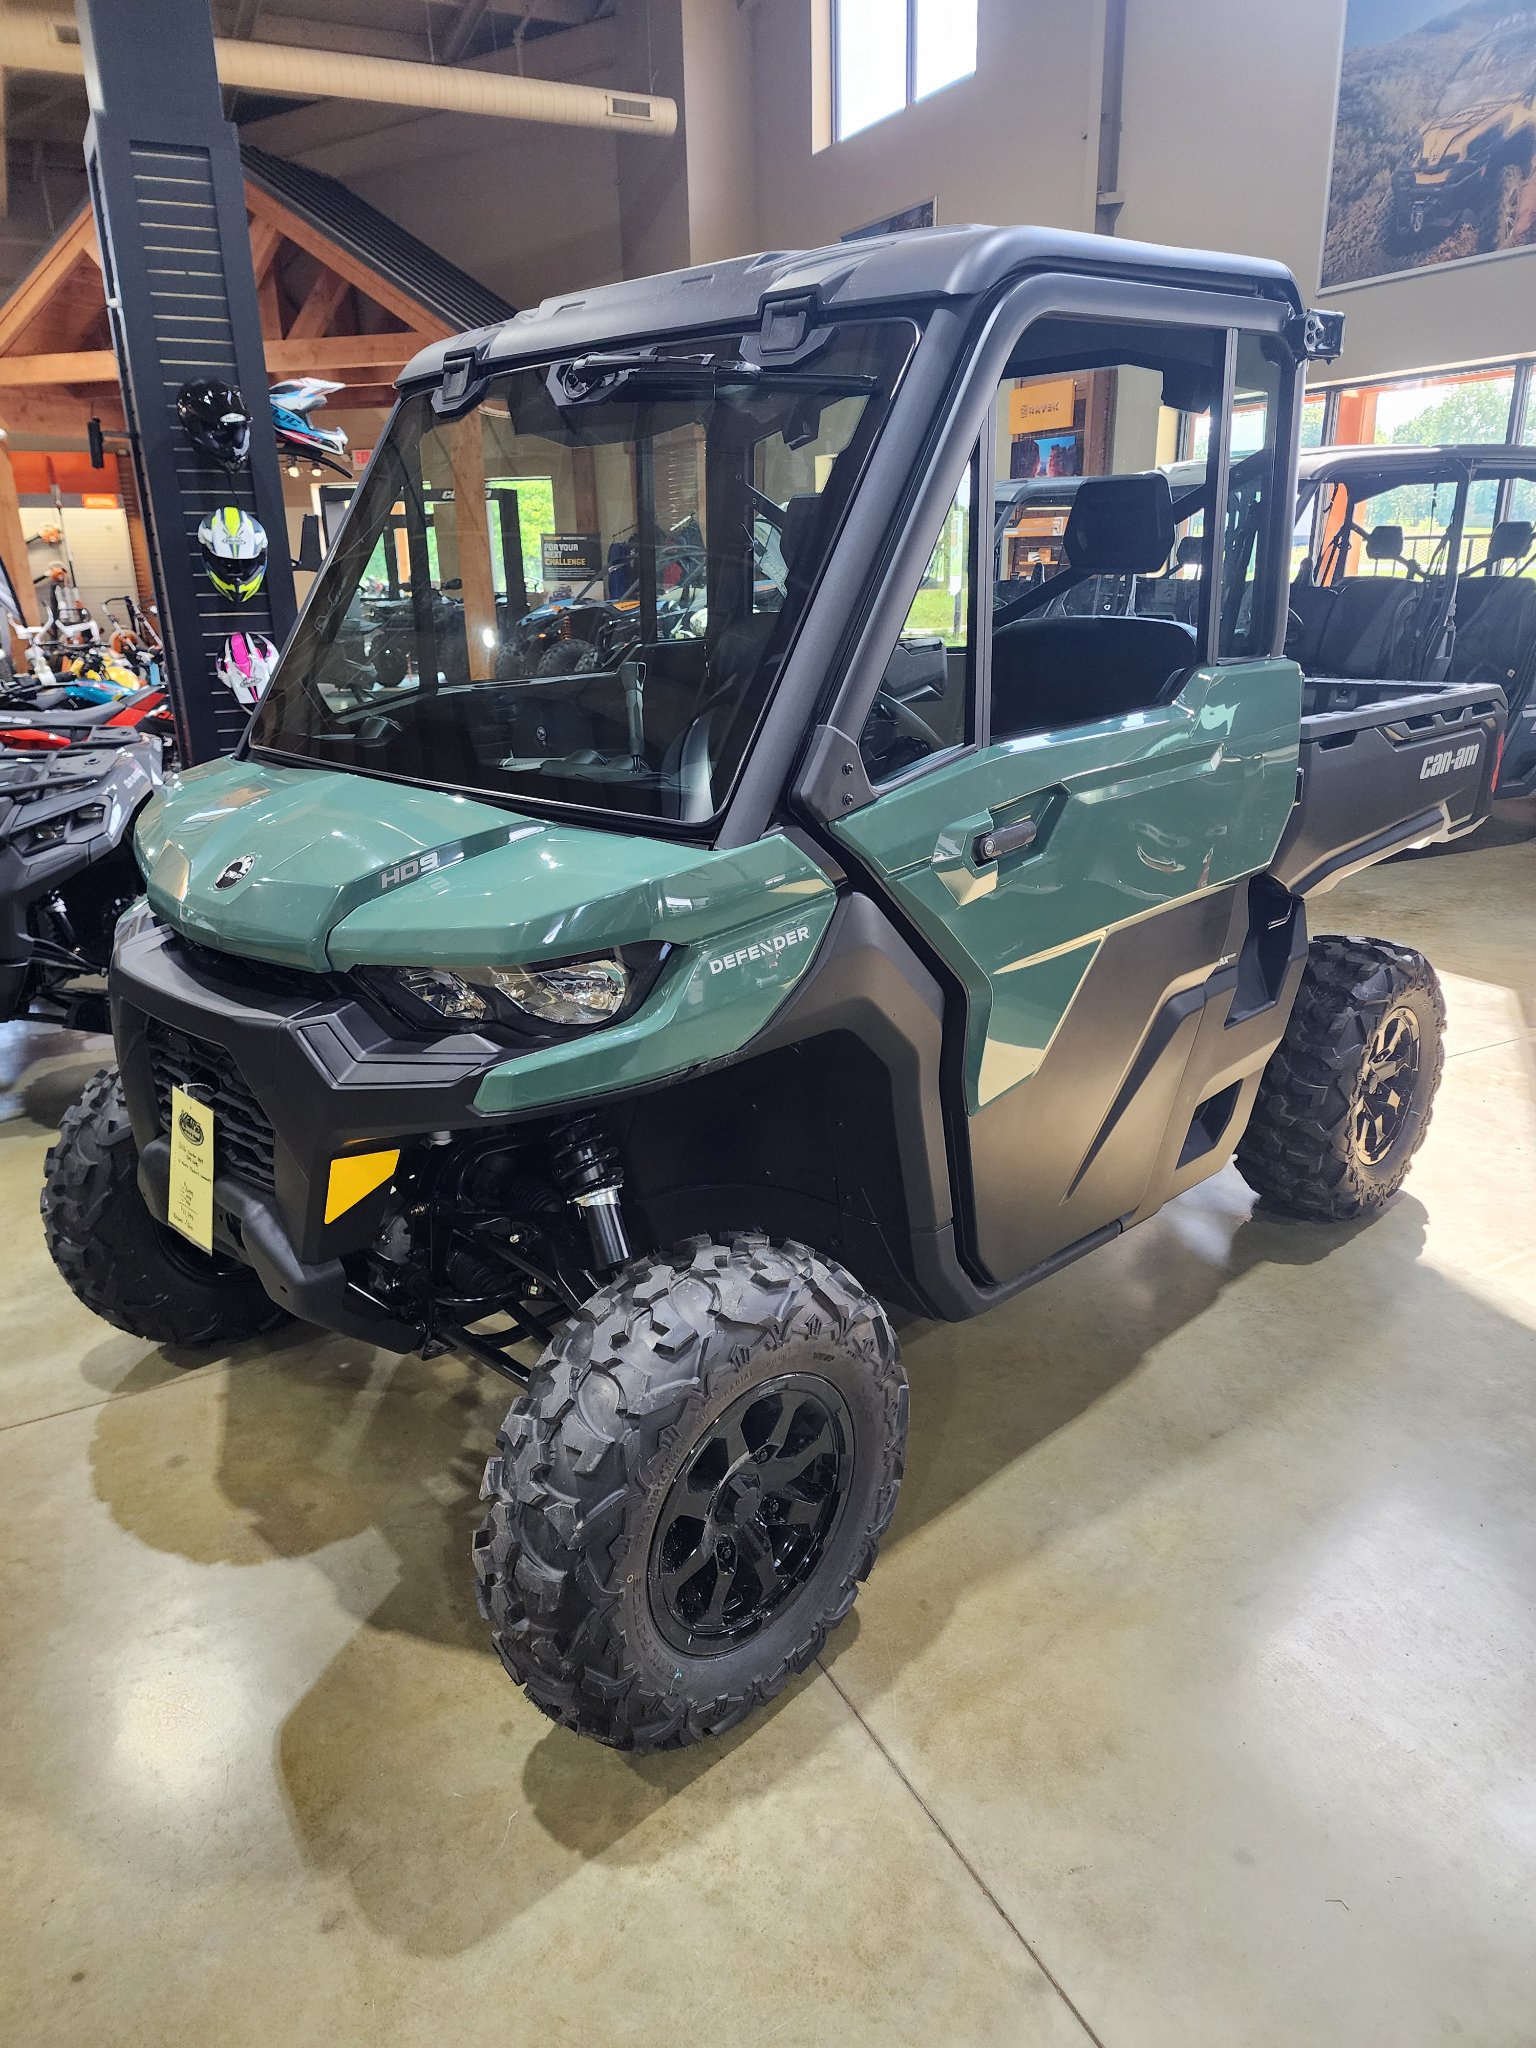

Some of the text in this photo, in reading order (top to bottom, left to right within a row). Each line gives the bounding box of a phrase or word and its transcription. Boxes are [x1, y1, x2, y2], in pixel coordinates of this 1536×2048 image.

[544, 543, 579, 551] FOR YOUR
[544, 558, 586, 566] CHALLENGE
[381, 851, 439, 889] HD9
[709, 926, 810, 975] DEFENDER
